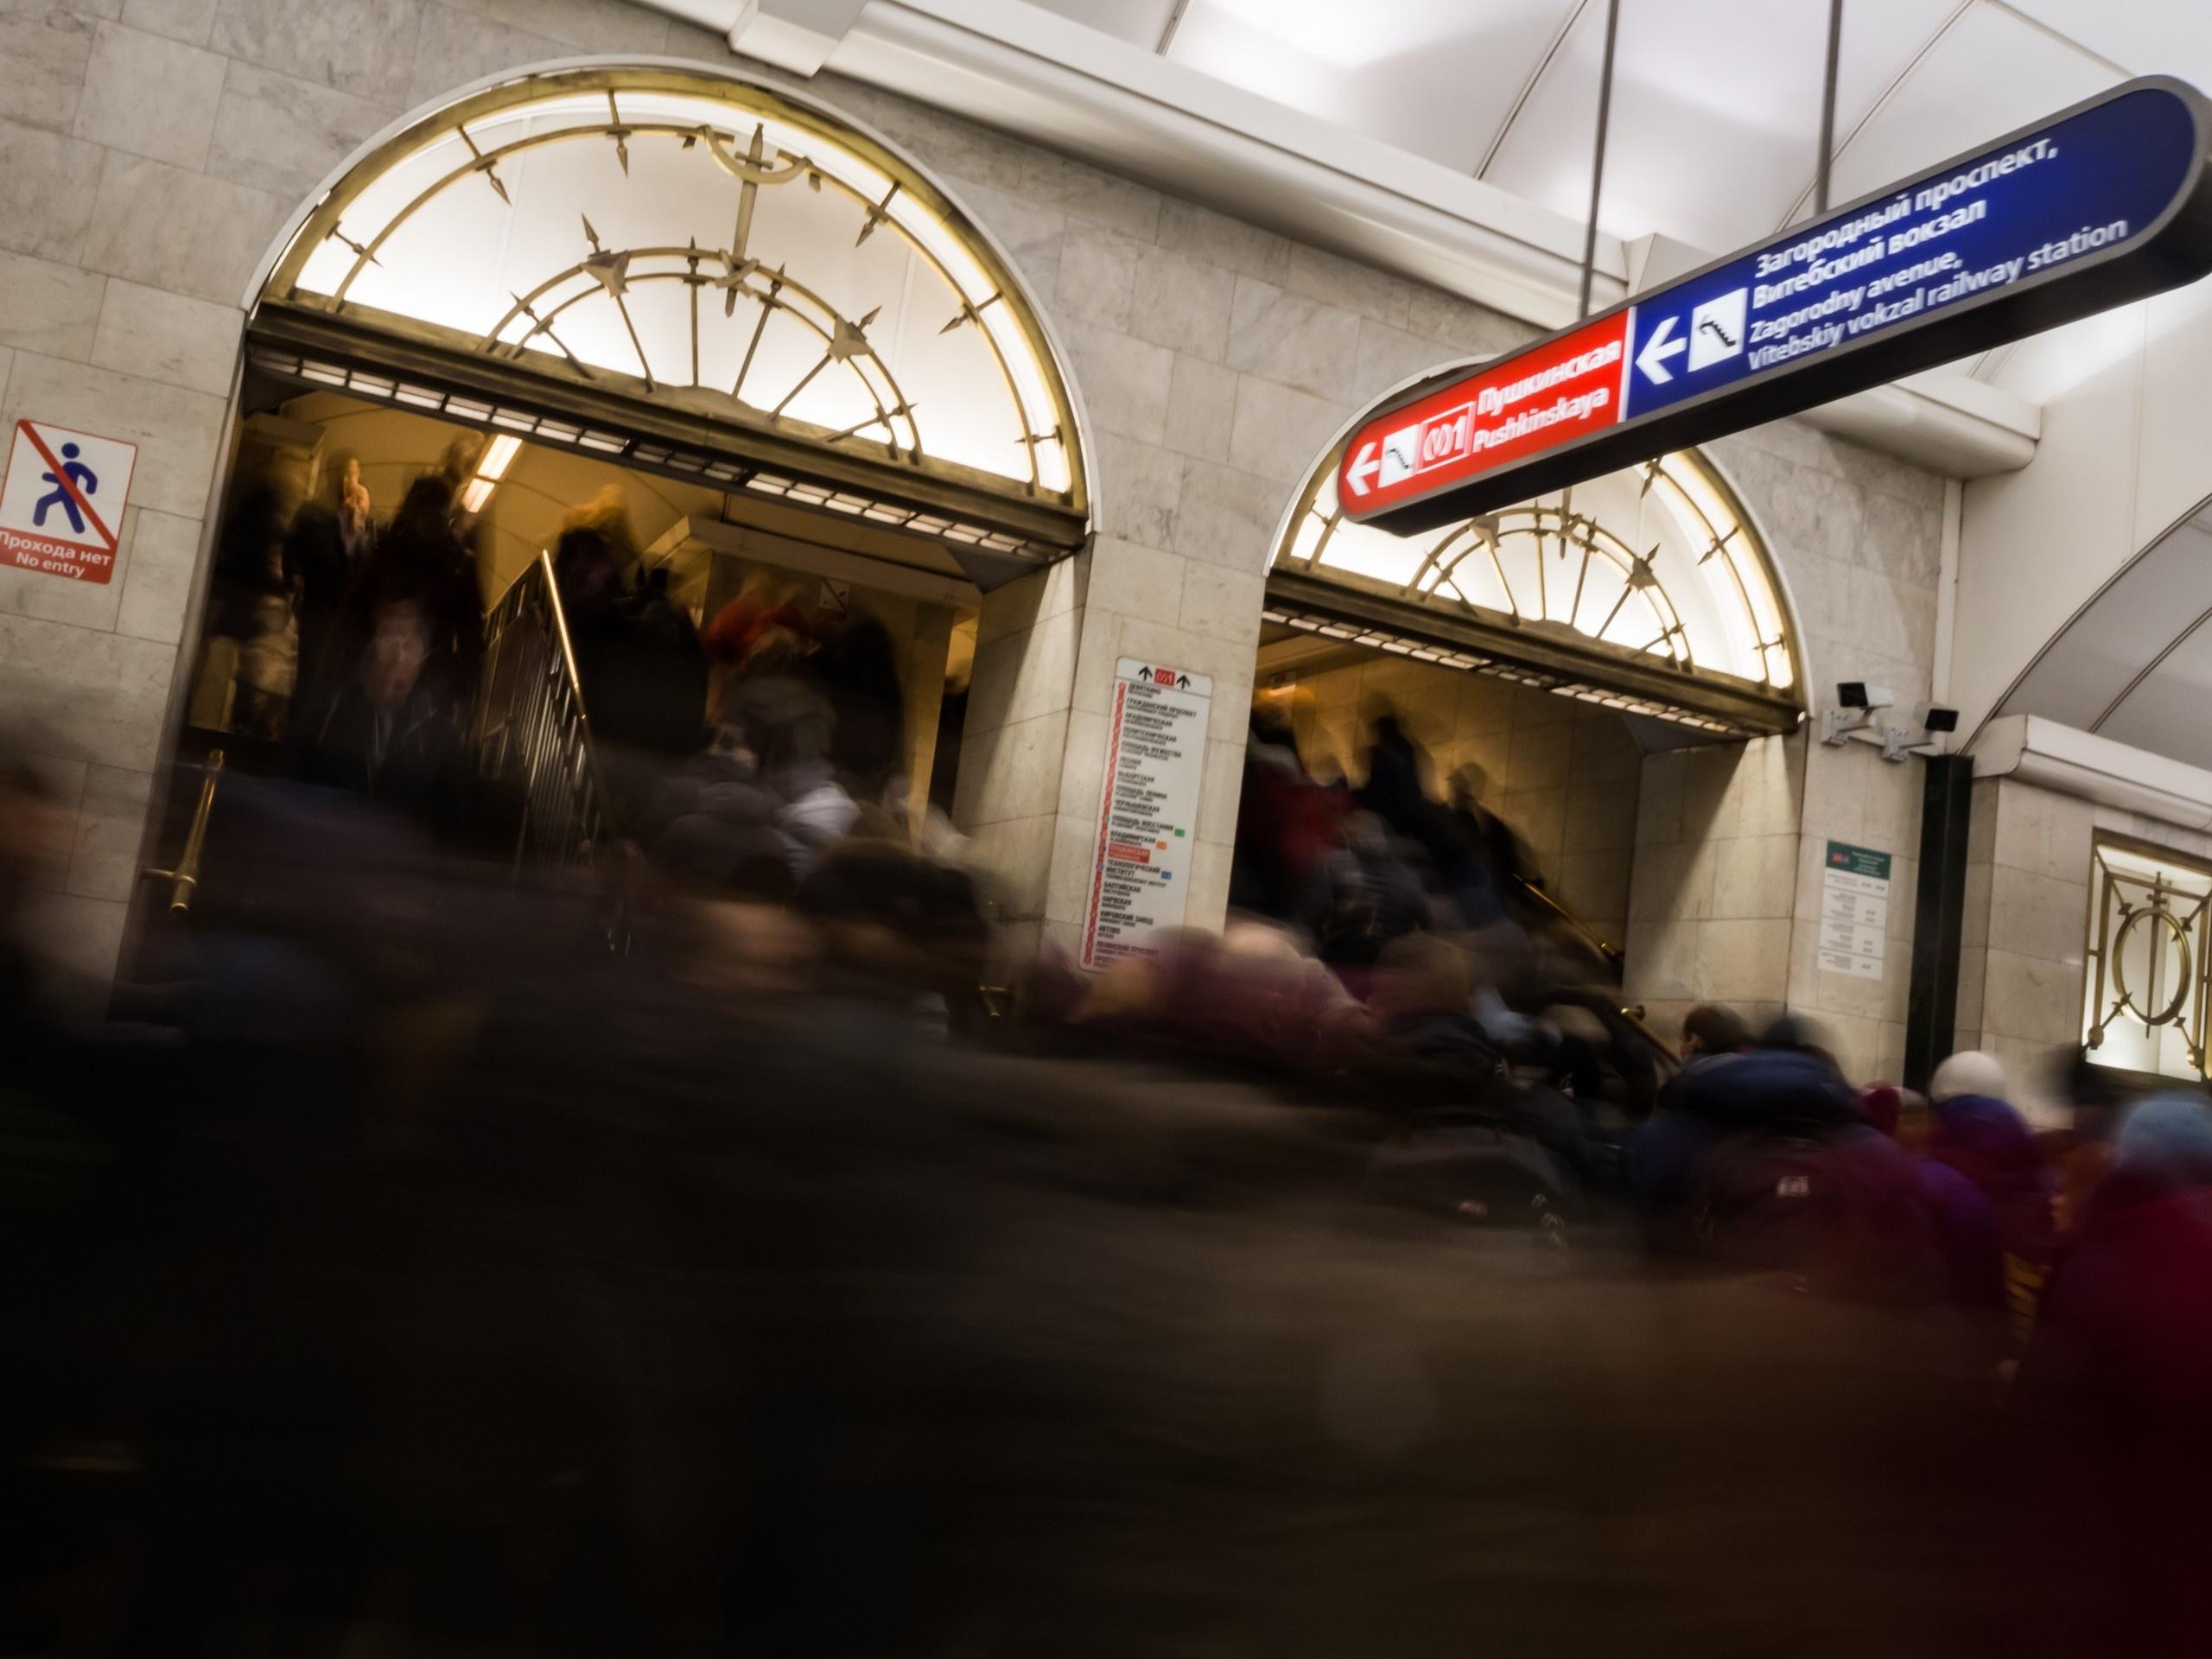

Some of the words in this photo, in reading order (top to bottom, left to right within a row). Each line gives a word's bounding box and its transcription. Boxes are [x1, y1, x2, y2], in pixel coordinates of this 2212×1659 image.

[1755, 193, 1911, 277] Загородный
[1914, 138, 2058, 211] проспект,
[1748, 322, 1846, 370] Vitebskiy
[1847, 287, 1924, 334] vokzal
[1927, 257, 2024, 306] railway
[2027, 219, 2128, 270] station
[1752, 236, 1885, 309] Витебский
[1888, 200, 1986, 255] вокзал
[1749, 286, 1866, 343] Zagorodny
[1866, 251, 1962, 298] avenue,
[1472, 387, 1609, 453] Pushkinskaya
[1477, 340, 1622, 416] Пушкинская
[0, 531, 76, 560] Прохода
[79, 551, 111, 566] нет
[16, 552, 39, 567] No
[42, 559, 86, 578] entry
